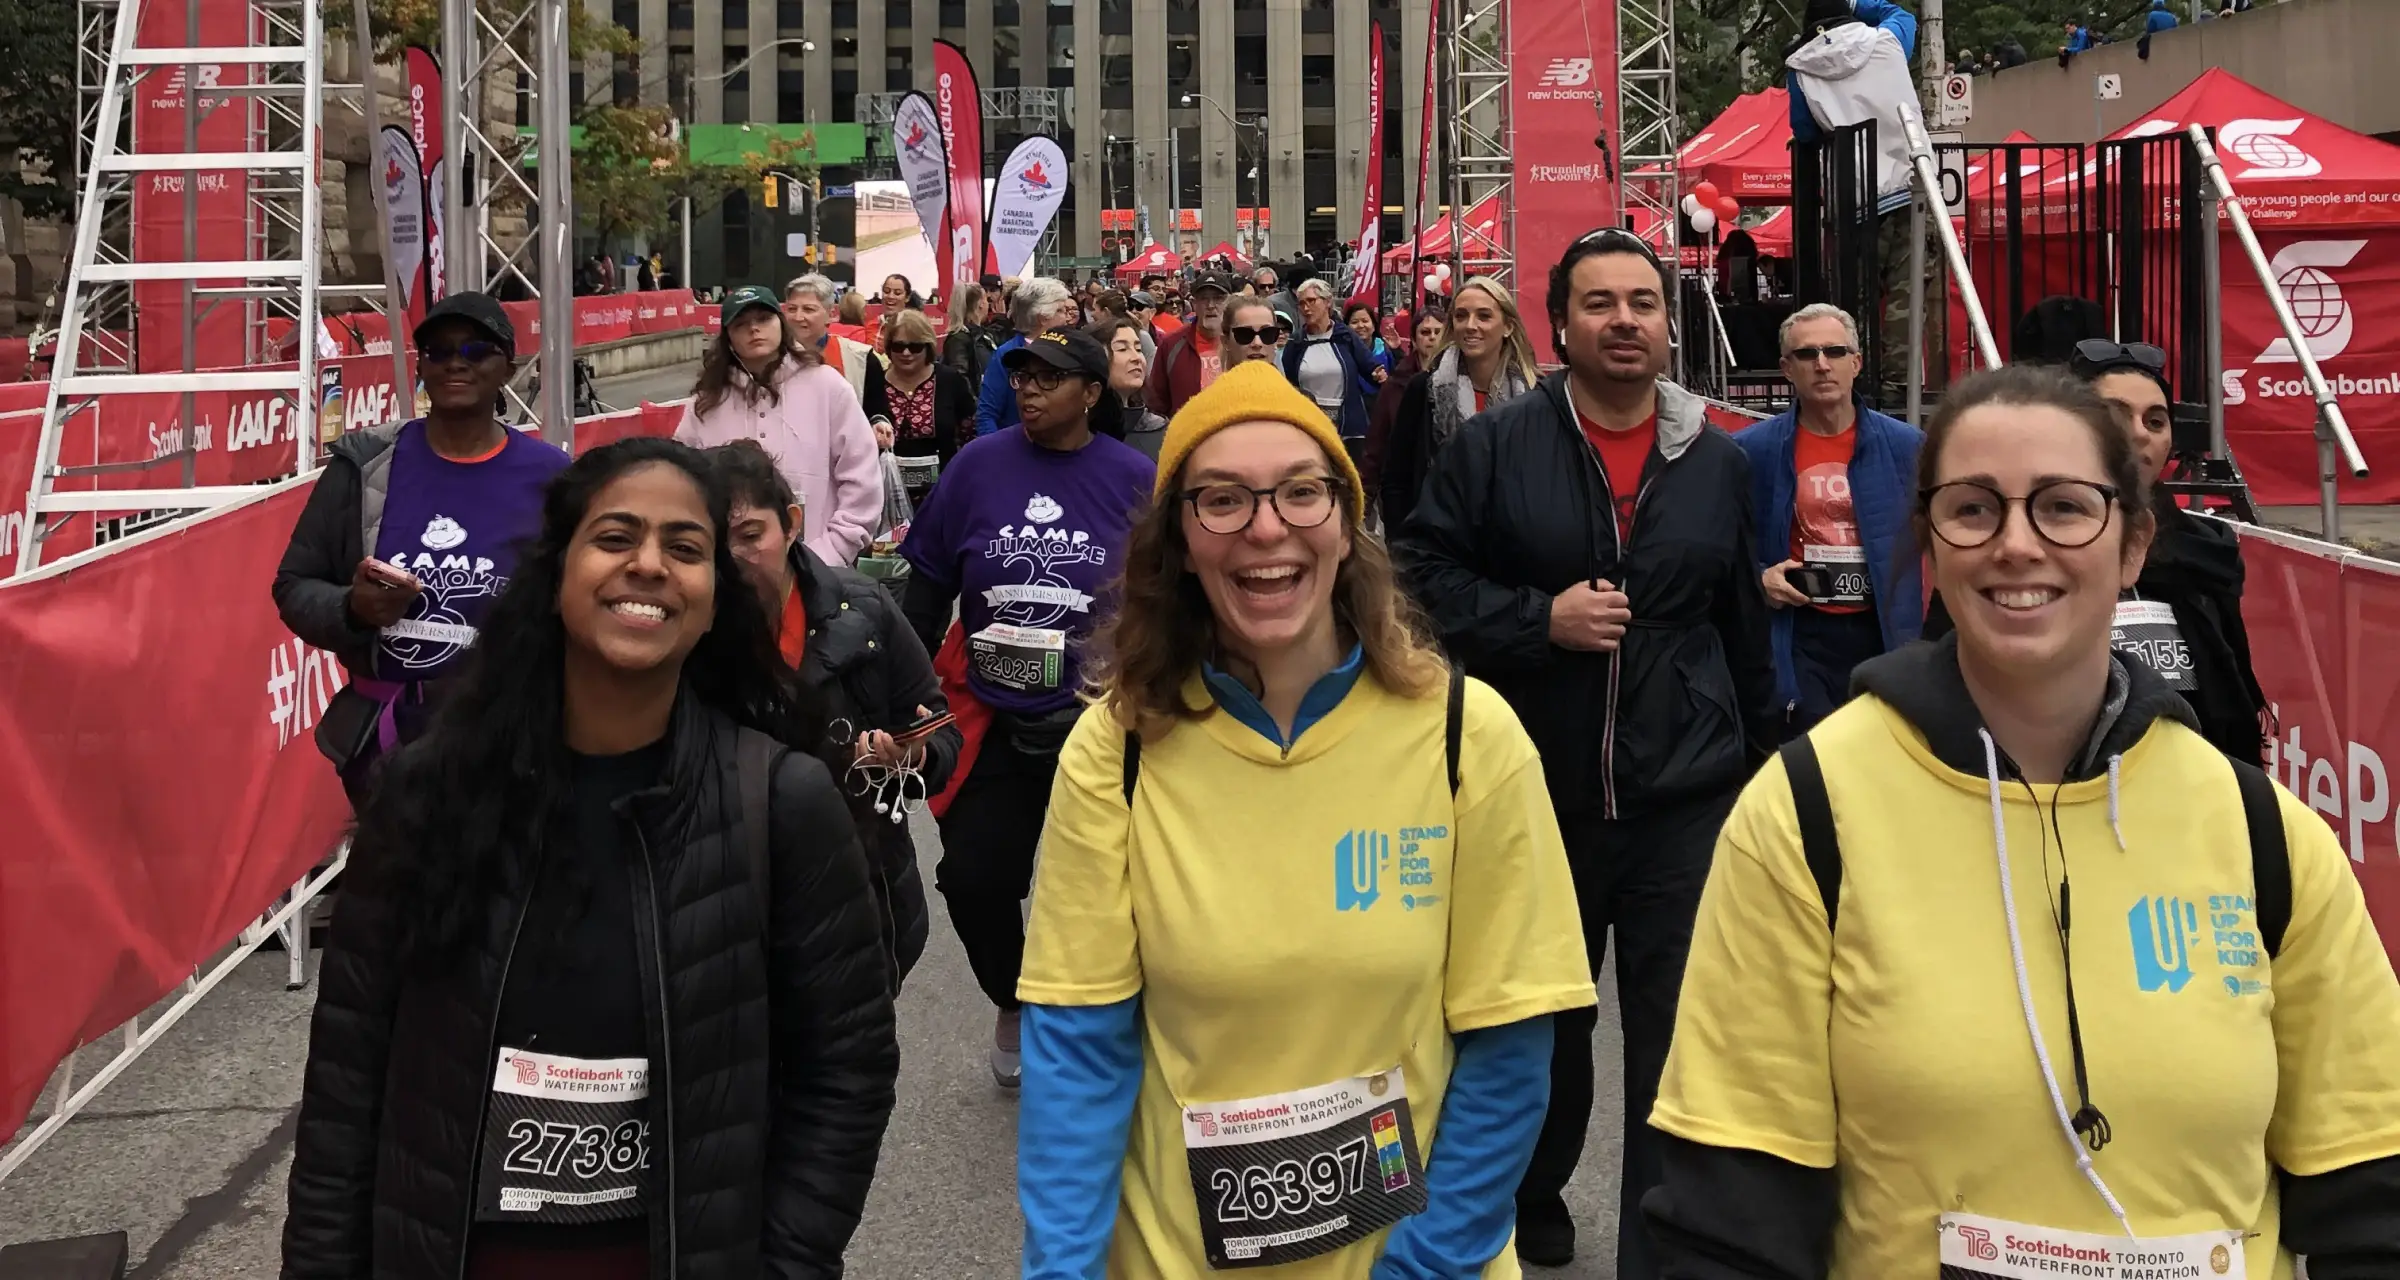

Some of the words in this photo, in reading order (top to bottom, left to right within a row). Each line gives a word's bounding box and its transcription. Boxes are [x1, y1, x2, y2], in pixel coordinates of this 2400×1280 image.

[1527, 90, 1552, 100] new
[152, 98, 179, 109] new
[1742, 172, 1764, 183] Every
[1765, 173, 1782, 183] step
[2238, 195, 2257, 206] elps
[2260, 194, 2297, 207] young
[2300, 192, 2341, 208] people
[2343, 191, 2366, 203] and
[2369, 193, 2390, 203] our
[1003, 209, 1033, 218] CANADIAN
[2252, 208, 2297, 219] Challenge
[1001, 217, 1035, 227] MARATHON
[996, 226, 1039, 237] CHAMPIONSHIP
[2258, 372, 2400, 398] Scotabank
[999, 524, 1090, 544] CAMP
[985, 537, 1106, 565] JUMOKE
[389, 552, 495, 573] CAMP
[993, 551, 1083, 629] 25
[997, 588, 1076, 602] ANNIVERSARY
[2111, 640, 2195, 670] 5155
[975, 651, 1041, 684] 22025
[1399, 826, 1448, 840] STAND
[1400, 842, 1419, 855] UP
[1400, 857, 1430, 870] FOR
[1400, 872, 1433, 885] KIDS
[2211, 913, 2240, 929] UP
[2214, 931, 2255, 948] FOR
[2217, 950, 2259, 966] KIDS
[546, 1064, 623, 1082] Scotiabank
[544, 1079, 626, 1093] WATERFRONT
[1220, 1104, 1291, 1124] Scotiabank
[1294, 1091, 1349, 1113] TORONTO
[1222, 1116, 1297, 1136] WATERFRONT
[1300, 1095, 1364, 1124] MARATHON
[1212, 1136, 1368, 1223] 26397
[502, 1188, 553, 1202] TORONTO
[554, 1189, 622, 1204] WATERFRONT
[622, 1187, 637, 1198] 5K
[501, 1199, 541, 1210] 10.20.19
[1225, 1237, 1267, 1248] TORONTO
[1269, 1223, 1334, 1246] WATERFRONT
[1334, 1216, 1349, 1229] 5K
[1226, 1247, 1261, 1258] 10.20.19
[2005, 1235, 2112, 1263] Scotiabank
[2116, 1251, 2185, 1266] TORONTO
[2005, 1253, 2116, 1279] WATERFRONT
[2120, 1265, 2200, 1280] MARATHON
